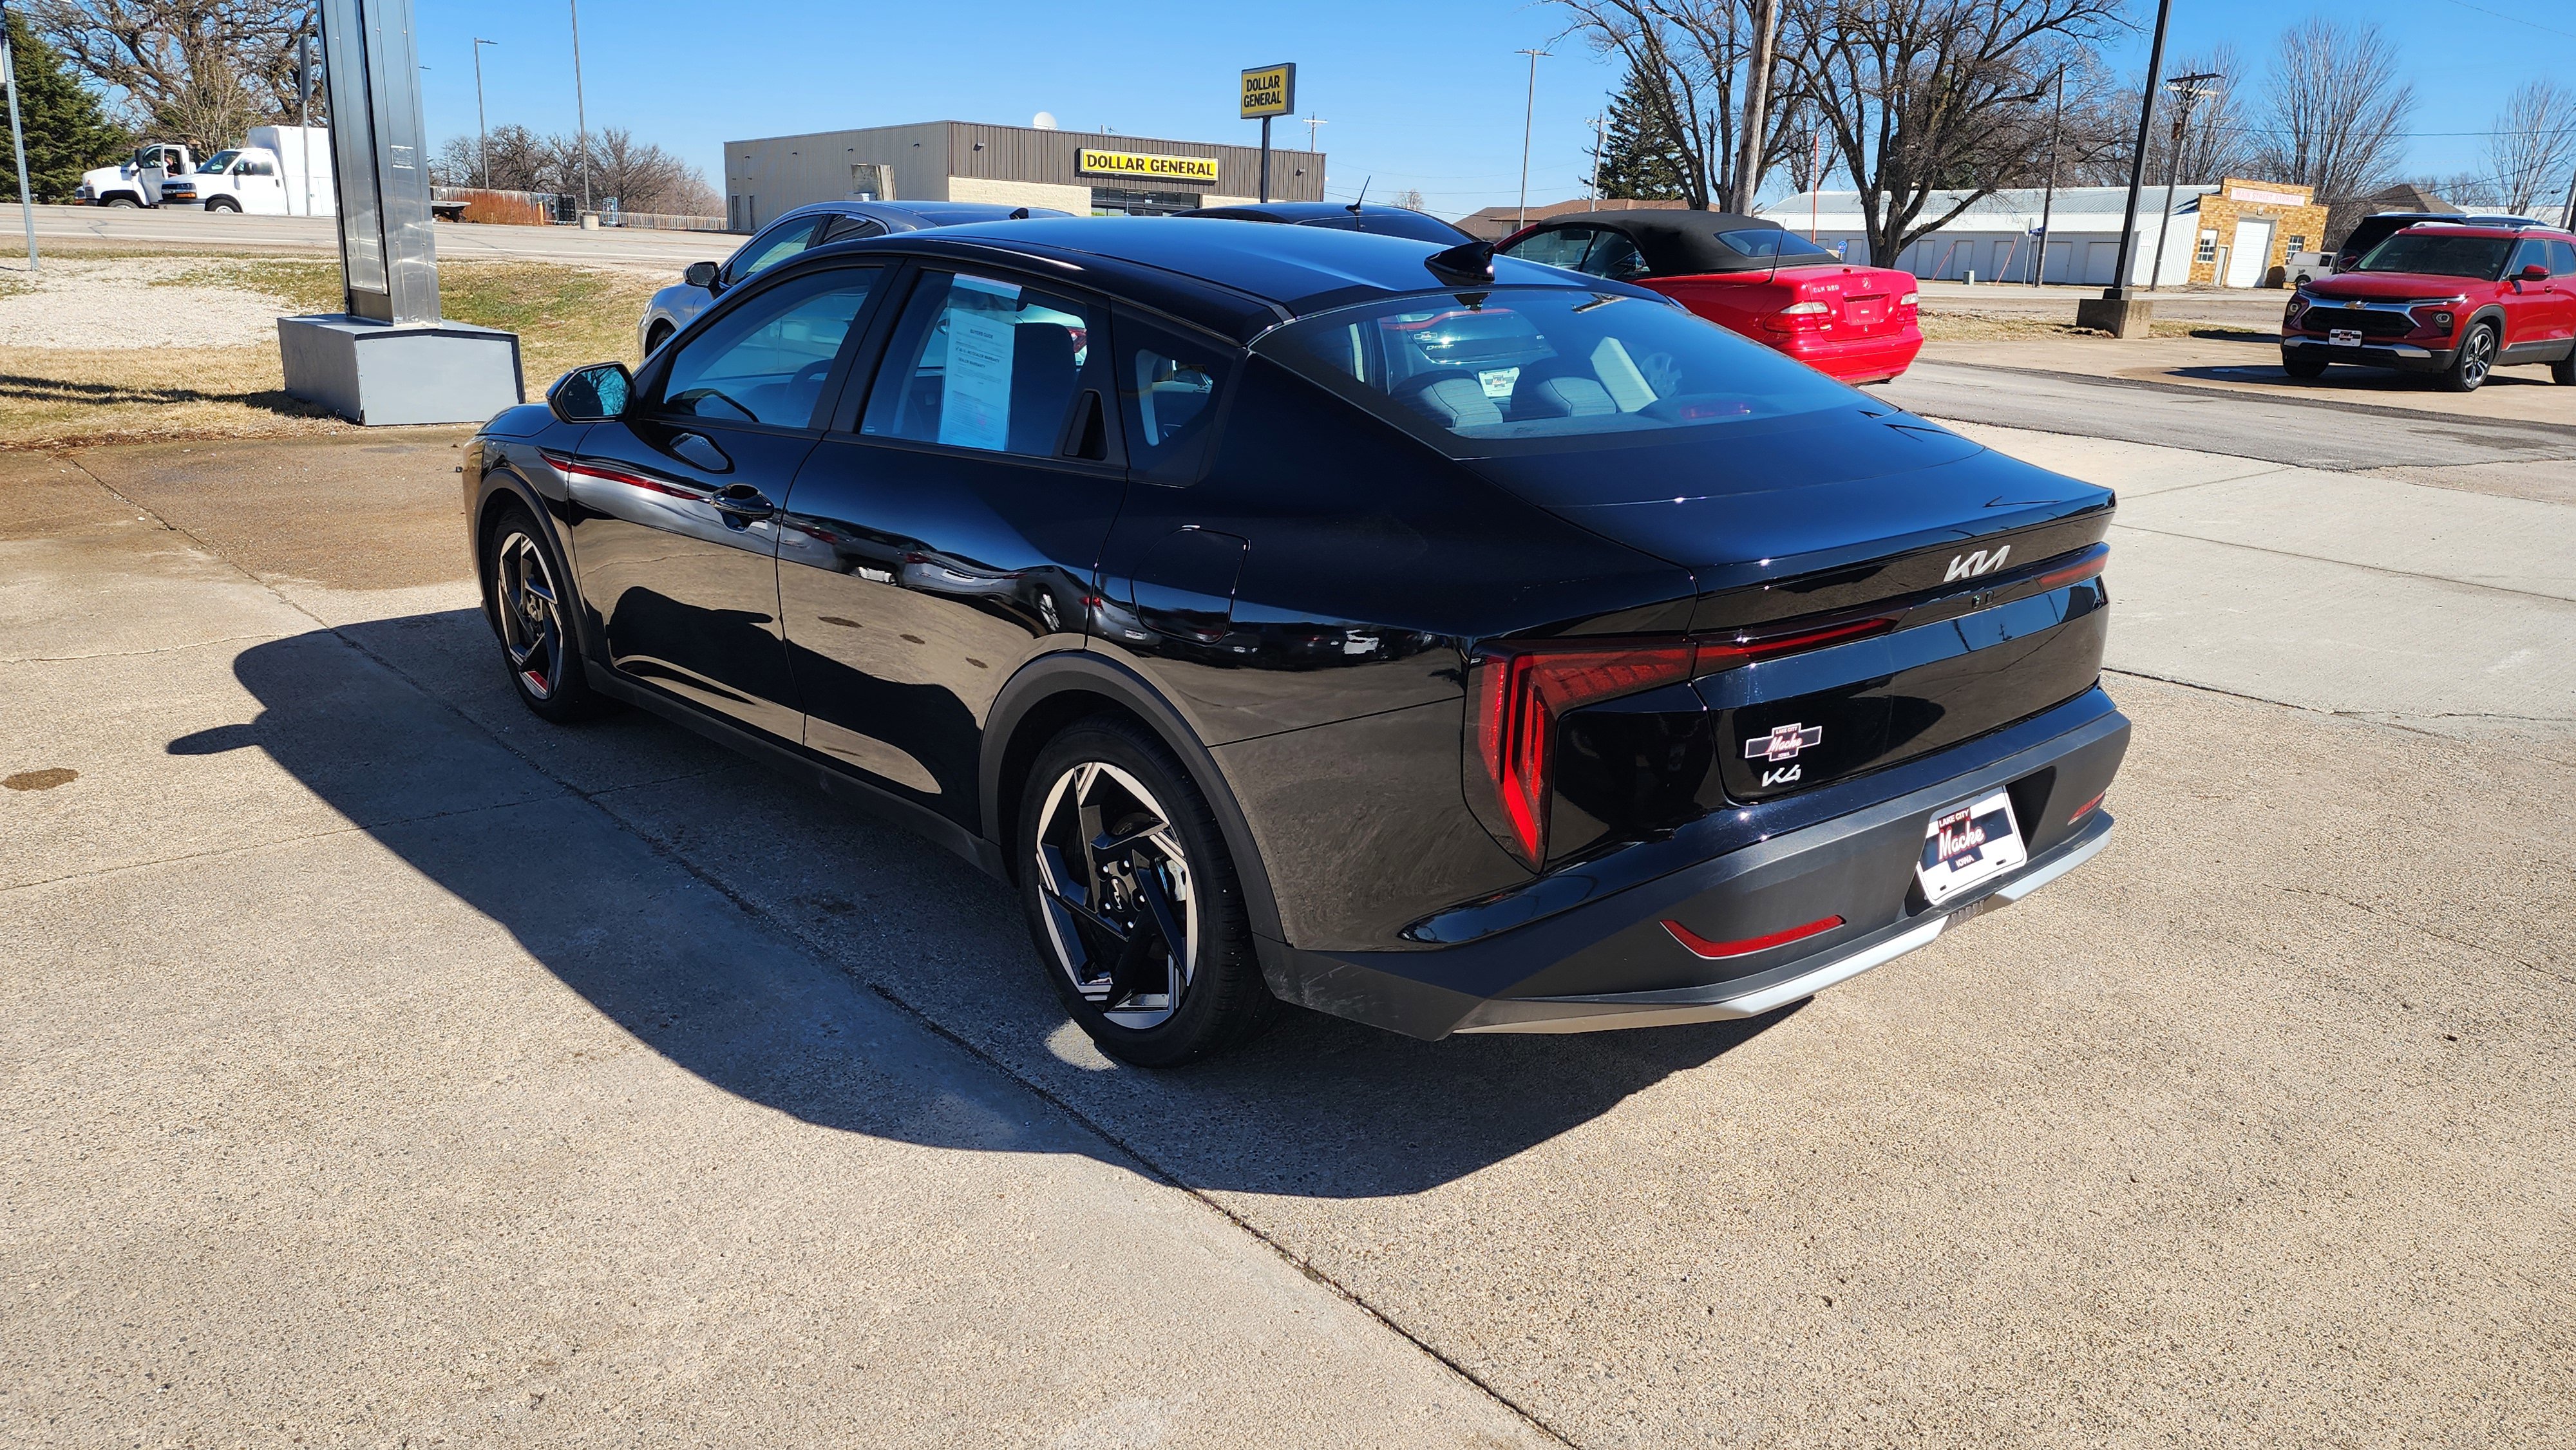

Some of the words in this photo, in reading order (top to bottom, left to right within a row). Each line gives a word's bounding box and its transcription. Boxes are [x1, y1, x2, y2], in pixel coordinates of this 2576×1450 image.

[1246, 75, 1280, 92] DOLLAR
[1244, 90, 1282, 108] GENERAL
[1086, 154, 1145, 171] DOLLAR
[1150, 158, 1214, 176] GENERAL
[2252, 193, 2273, 201] STREET
[2275, 194, 2301, 203] STORAGE
[1944, 545, 2011, 582] KIA
[1762, 764, 1801, 787] K4
[1939, 815, 1956, 827] LAKE
[1955, 809, 1969, 820] CITY
[1955, 854, 1975, 868] IOWA
